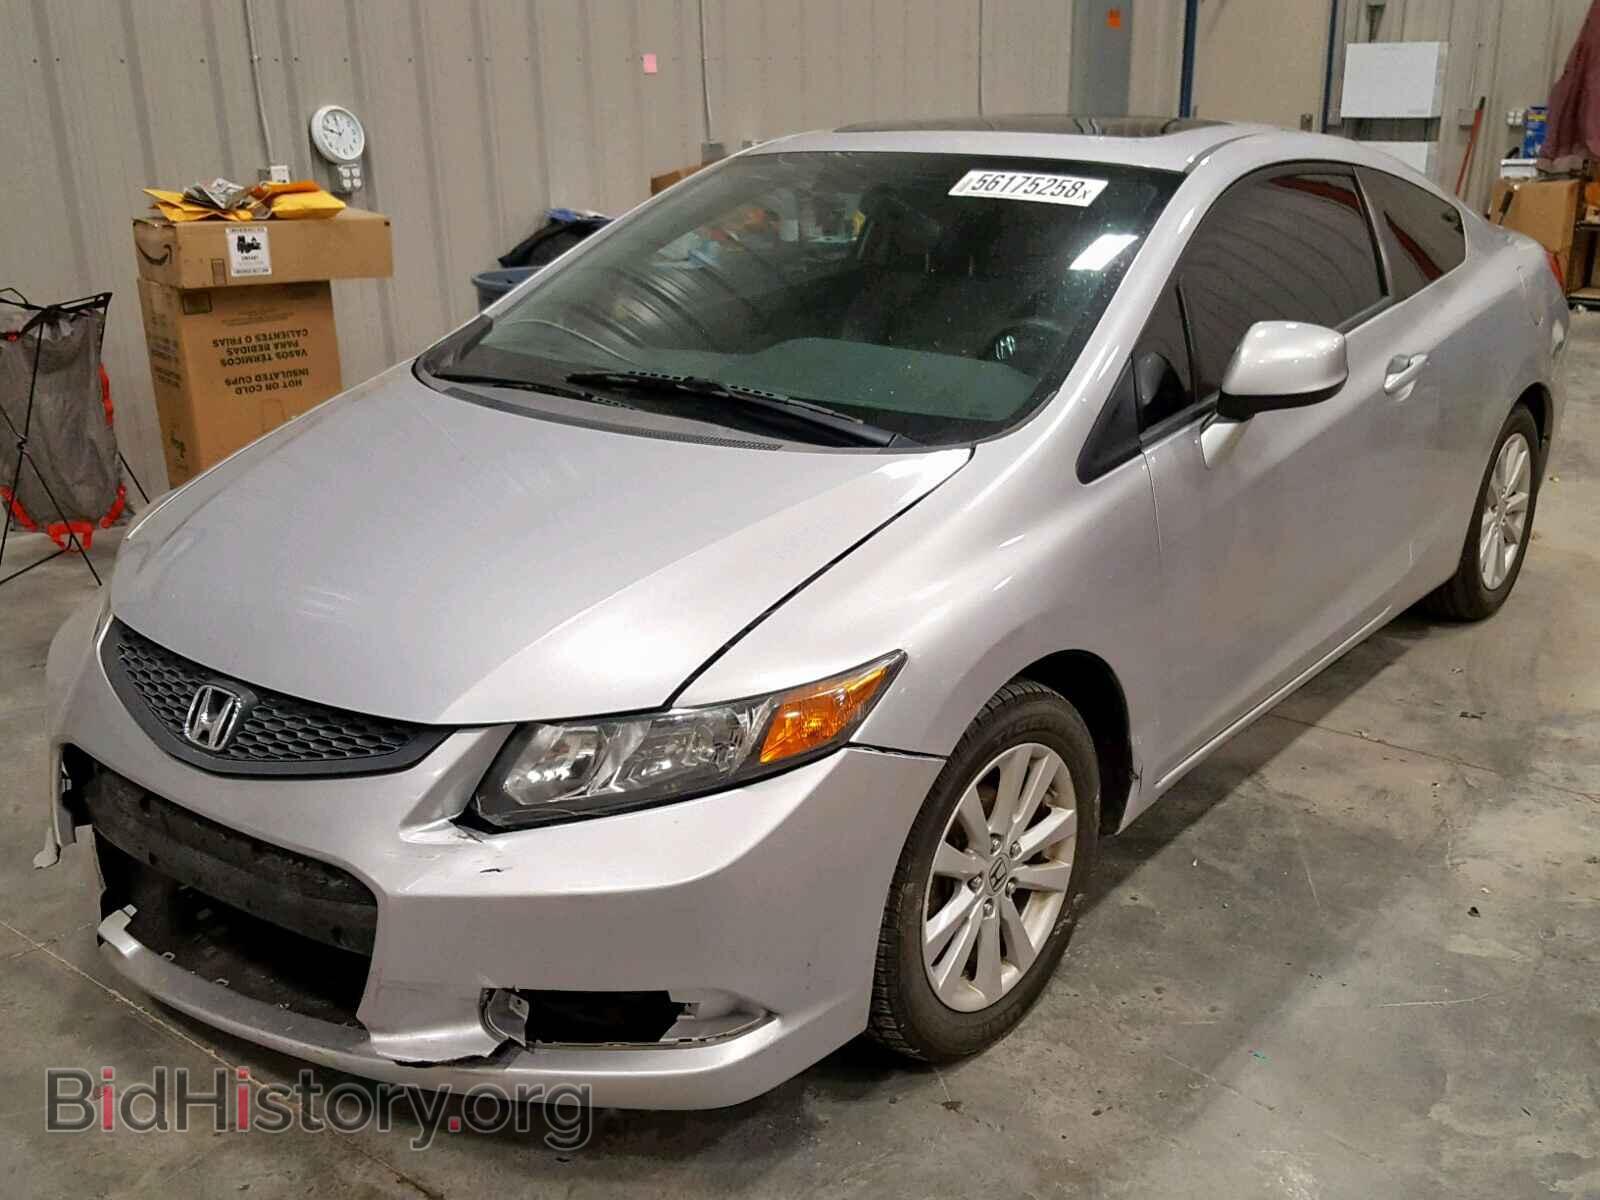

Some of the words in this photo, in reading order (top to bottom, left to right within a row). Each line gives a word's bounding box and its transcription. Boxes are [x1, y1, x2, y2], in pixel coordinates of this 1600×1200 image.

[254, 328, 309, 341] CALIENTES
[226, 344, 271, 356] BEBIDAS
[273, 340, 299, 350] PARA
[275, 349, 308, 361] VASOS
[224, 375, 253, 386] CUPS
[254, 368, 310, 382] INSULATED
[234, 384, 263, 395] COLD
[265, 382, 279, 391] OR
[283, 379, 303, 389] HOT
